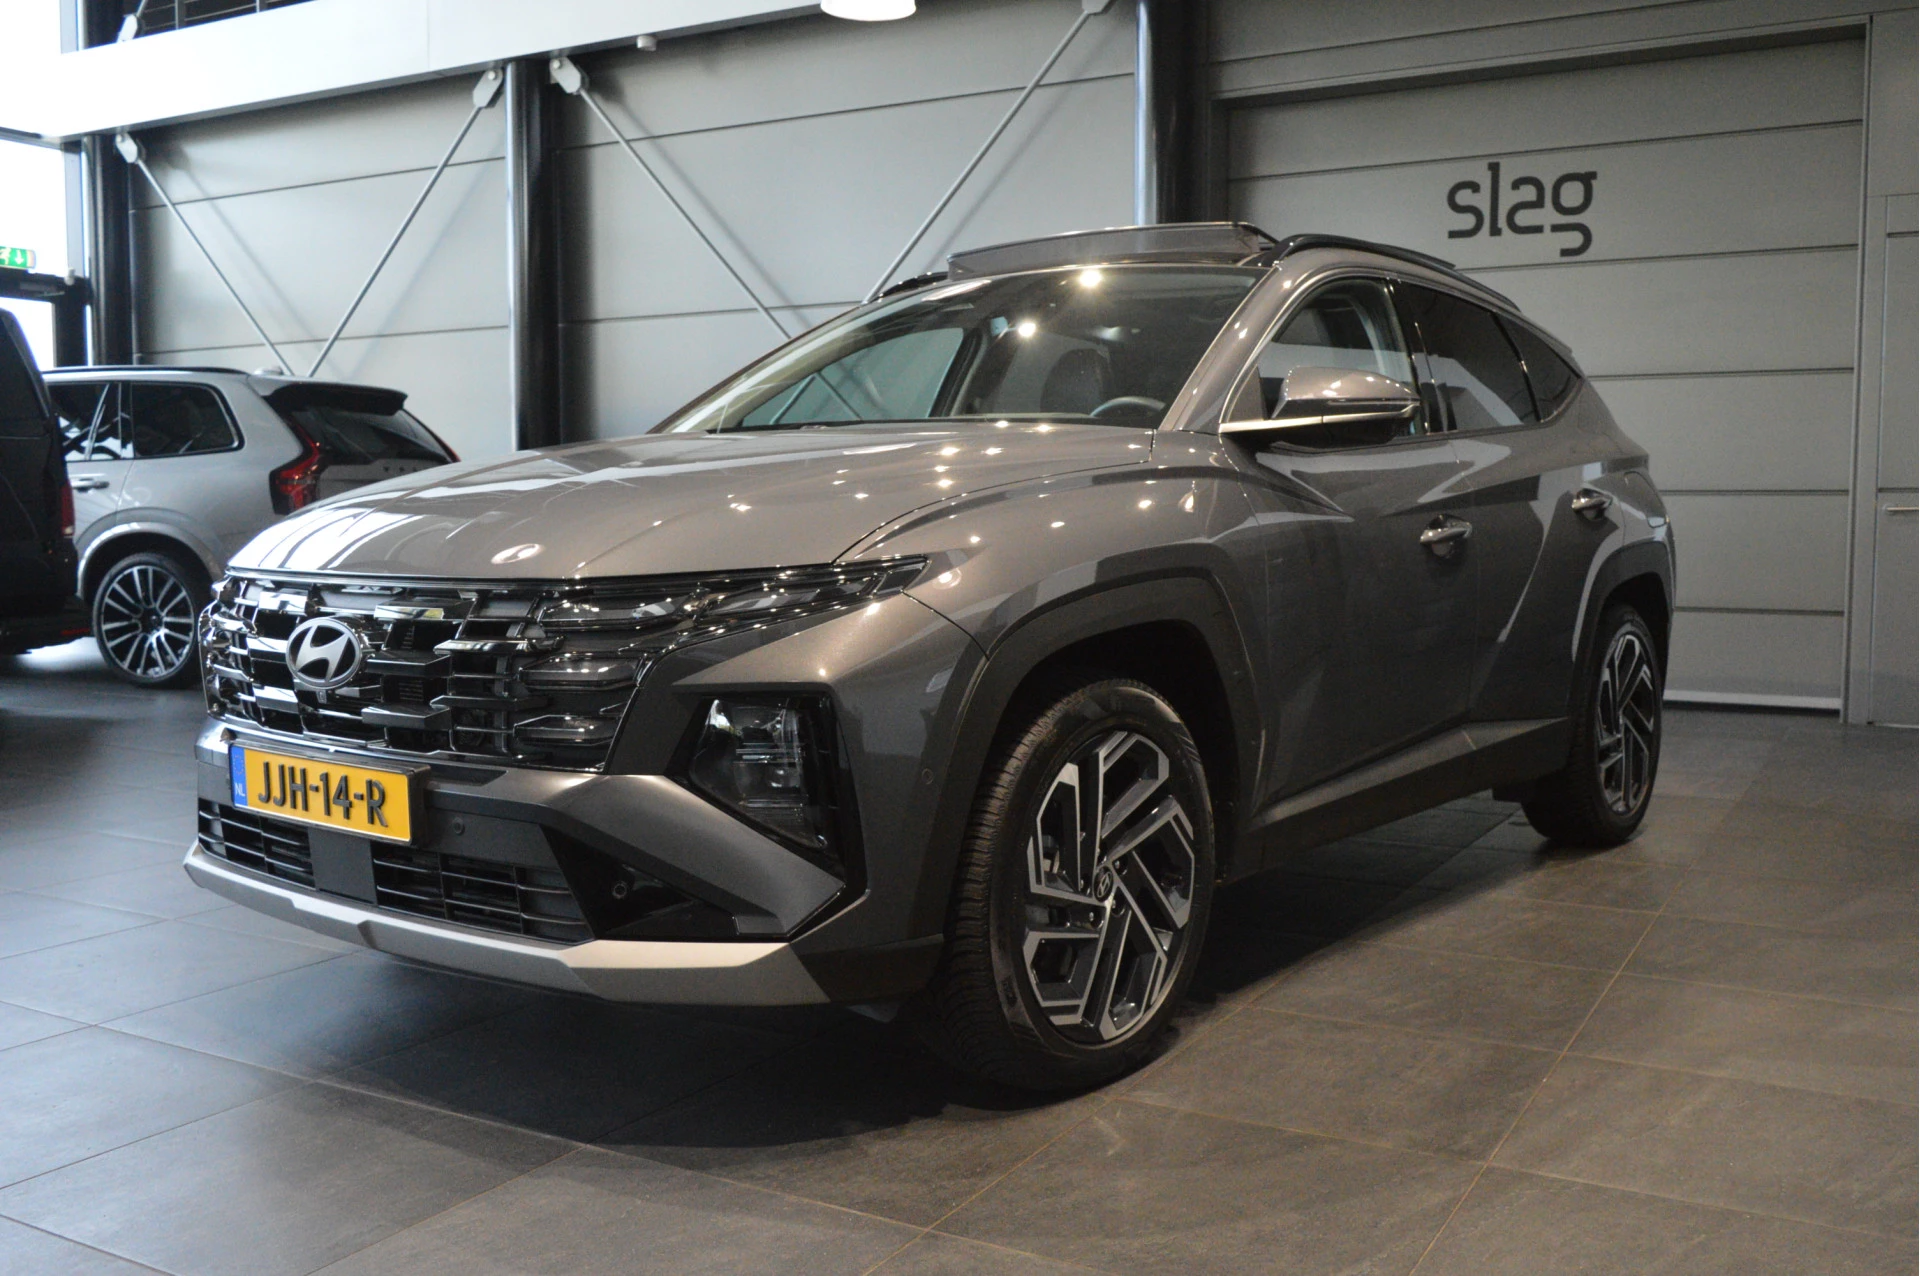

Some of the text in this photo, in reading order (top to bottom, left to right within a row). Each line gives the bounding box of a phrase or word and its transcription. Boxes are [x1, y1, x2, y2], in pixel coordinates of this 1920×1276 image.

[1447, 162, 1597, 257] slag
[234, 782, 246, 797] NL
[258, 761, 388, 827] JJH-14-R
